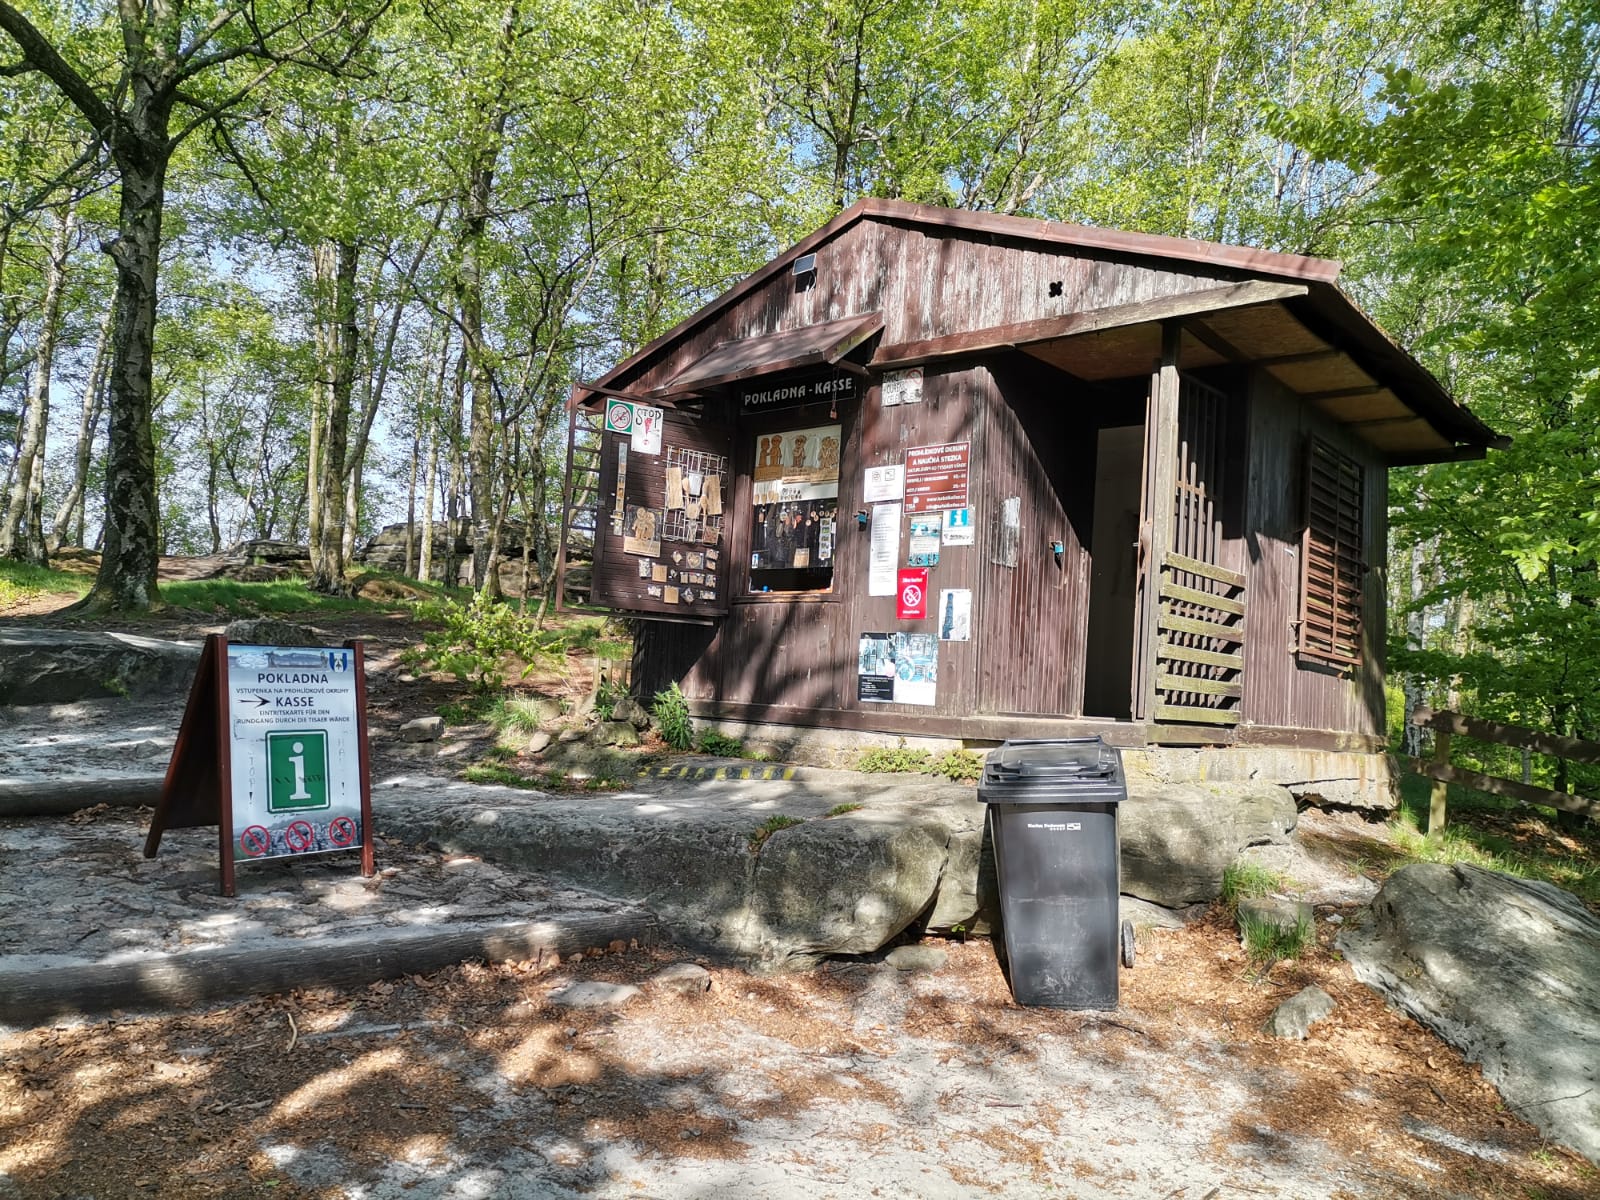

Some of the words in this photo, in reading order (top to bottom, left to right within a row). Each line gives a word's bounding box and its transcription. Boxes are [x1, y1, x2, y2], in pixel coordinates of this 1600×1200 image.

[744, 385, 806, 406] POKLADNA
[815, 377, 853, 395] KASSE
[635, 408, 662, 429] STOP
[257, 673, 329, 684] POKLADNA
[275, 696, 314, 707] KASSE
